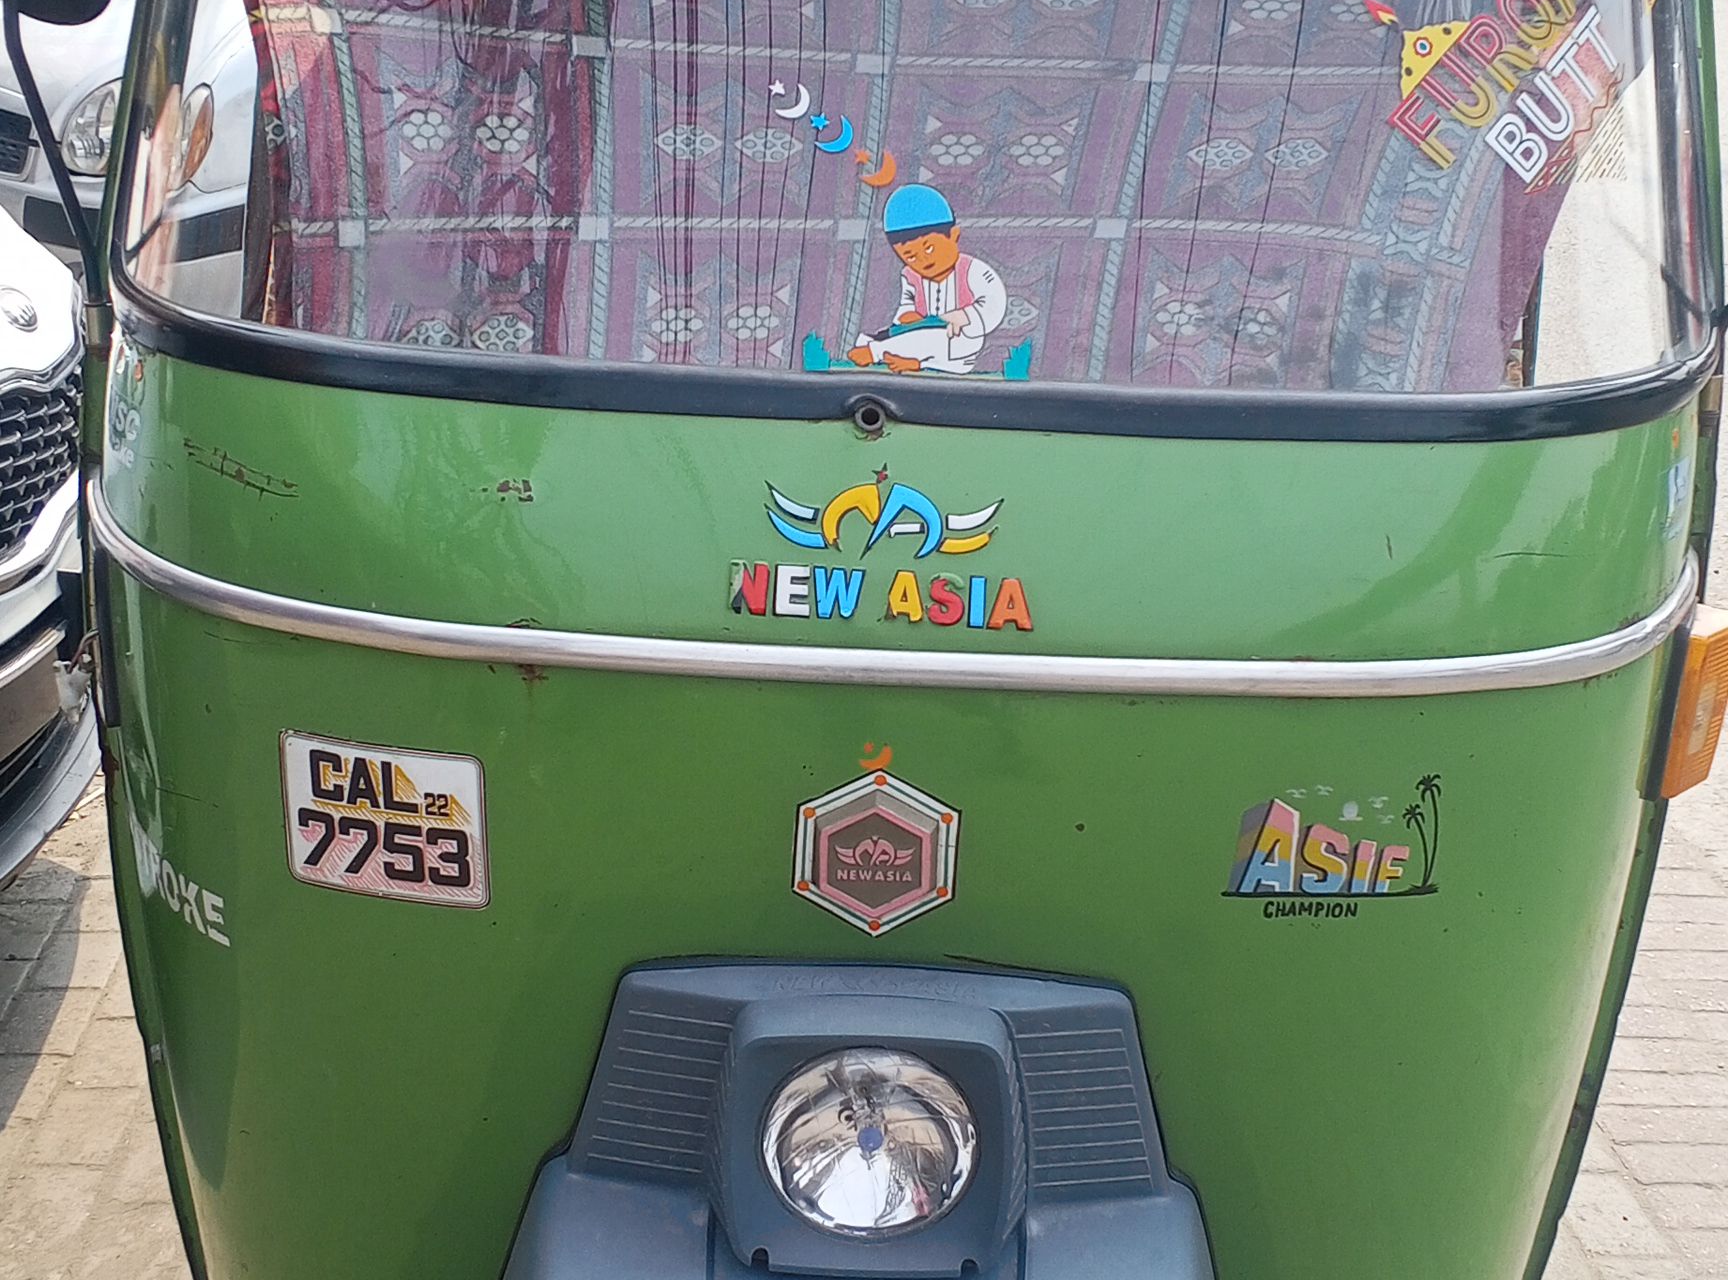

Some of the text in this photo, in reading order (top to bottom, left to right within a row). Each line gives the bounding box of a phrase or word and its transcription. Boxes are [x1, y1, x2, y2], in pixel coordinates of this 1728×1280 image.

[1484, 4, 1619, 183] BUTT
[729, 559, 1034, 632] NEW ASIA
[309, 749, 450, 817] CAL 22
[298, 807, 471, 888] 7753
[1231, 797, 1411, 894] ASIF
[1262, 900, 1359, 919] CHAMPION
